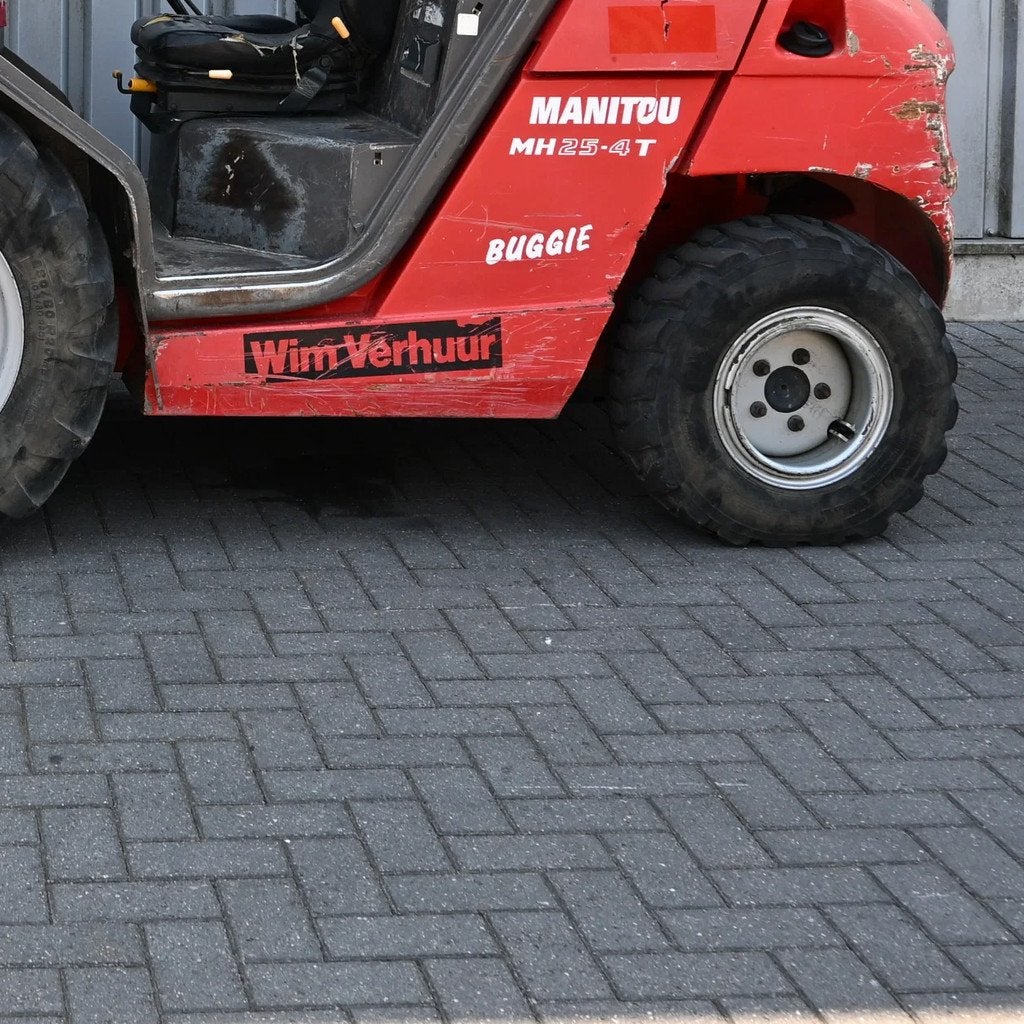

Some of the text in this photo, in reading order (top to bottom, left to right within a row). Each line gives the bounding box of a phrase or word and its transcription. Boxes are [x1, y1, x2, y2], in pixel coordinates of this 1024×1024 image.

[529, 97, 681, 125] MANITOU
[485, 224, 593, 265] BUGGIE
[250, 330, 496, 376] Wim Verhuur
